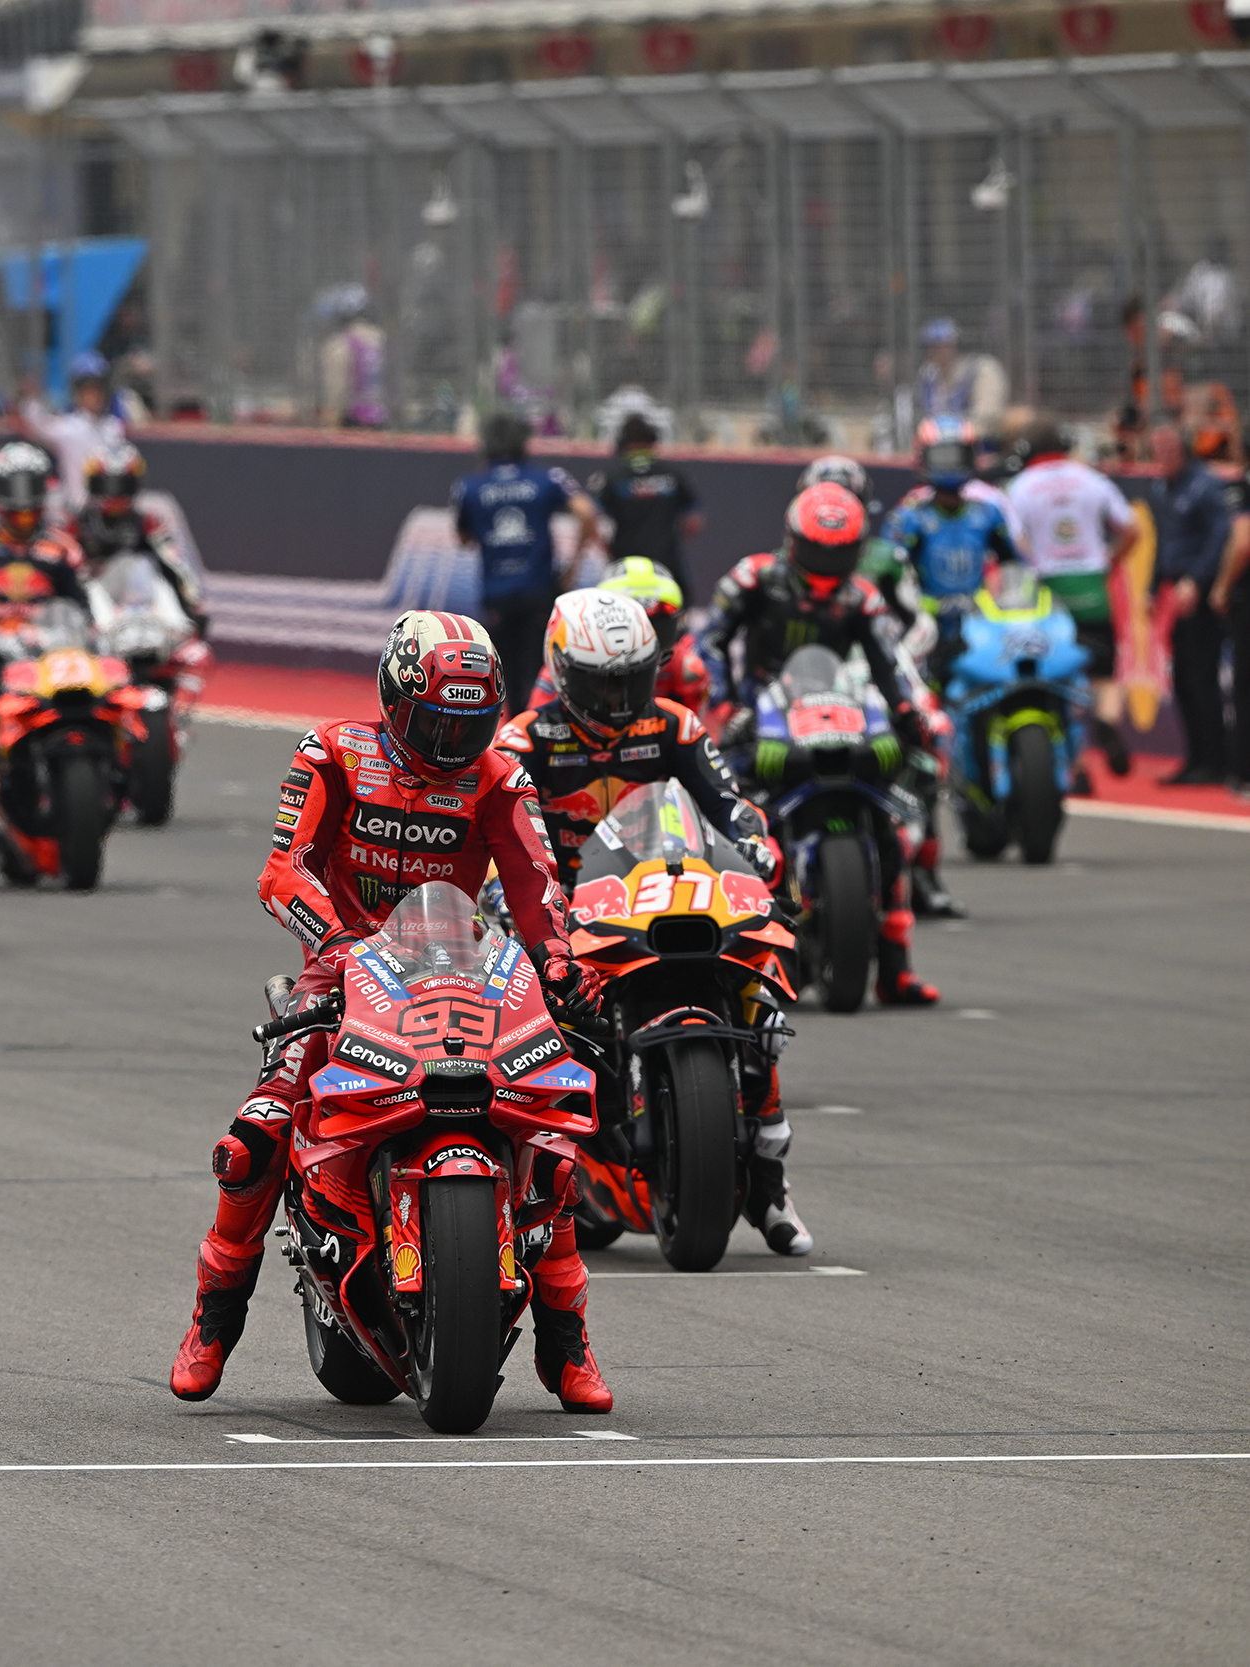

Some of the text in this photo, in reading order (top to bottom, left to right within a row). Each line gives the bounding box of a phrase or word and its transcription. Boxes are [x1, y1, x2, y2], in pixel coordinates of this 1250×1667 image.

[462, 651, 487, 661] Lenovo
[448, 688, 481, 700] SHOEI
[443, 707, 462, 715] Estrella
[342, 738, 375, 751] EATALY
[387, 727, 412, 761] Lenovo
[369, 759, 390, 770] riello
[390, 750, 404, 767] TIM
[359, 772, 389, 782] CARRERA
[281, 790, 305, 806] ba.it
[356, 785, 373, 795] SAP
[430, 795, 459, 808] SHOEI
[355, 808, 457, 845] Lenovo
[371, 851, 454, 877] NetApp
[631, 869, 719, 916] 37
[291, 900, 324, 934] Lenovo
[288, 916, 317, 949] Unipol
[500, 939, 521, 975] ADVANCE
[362, 958, 402, 991] ADVANCE
[508, 962, 537, 1003] riello
[350, 971, 392, 1014] riello
[345, 1018, 410, 1048] FRECCIAROSSA
[397, 997, 501, 1050] 93
[499, 1014, 551, 1047] FRECCIAROSSA
[340, 1038, 408, 1076] Lenovo
[436, 1059, 488, 1072] MONSTER
[501, 1038, 562, 1077] Lenovo
[339, 1079, 367, 1091] TIM
[558, 1076, 587, 1088] TIM
[373, 1090, 419, 1106] CARRERA
[495, 1088, 534, 1104] CARRERA
[427, 1147, 494, 1170] Lenovo
